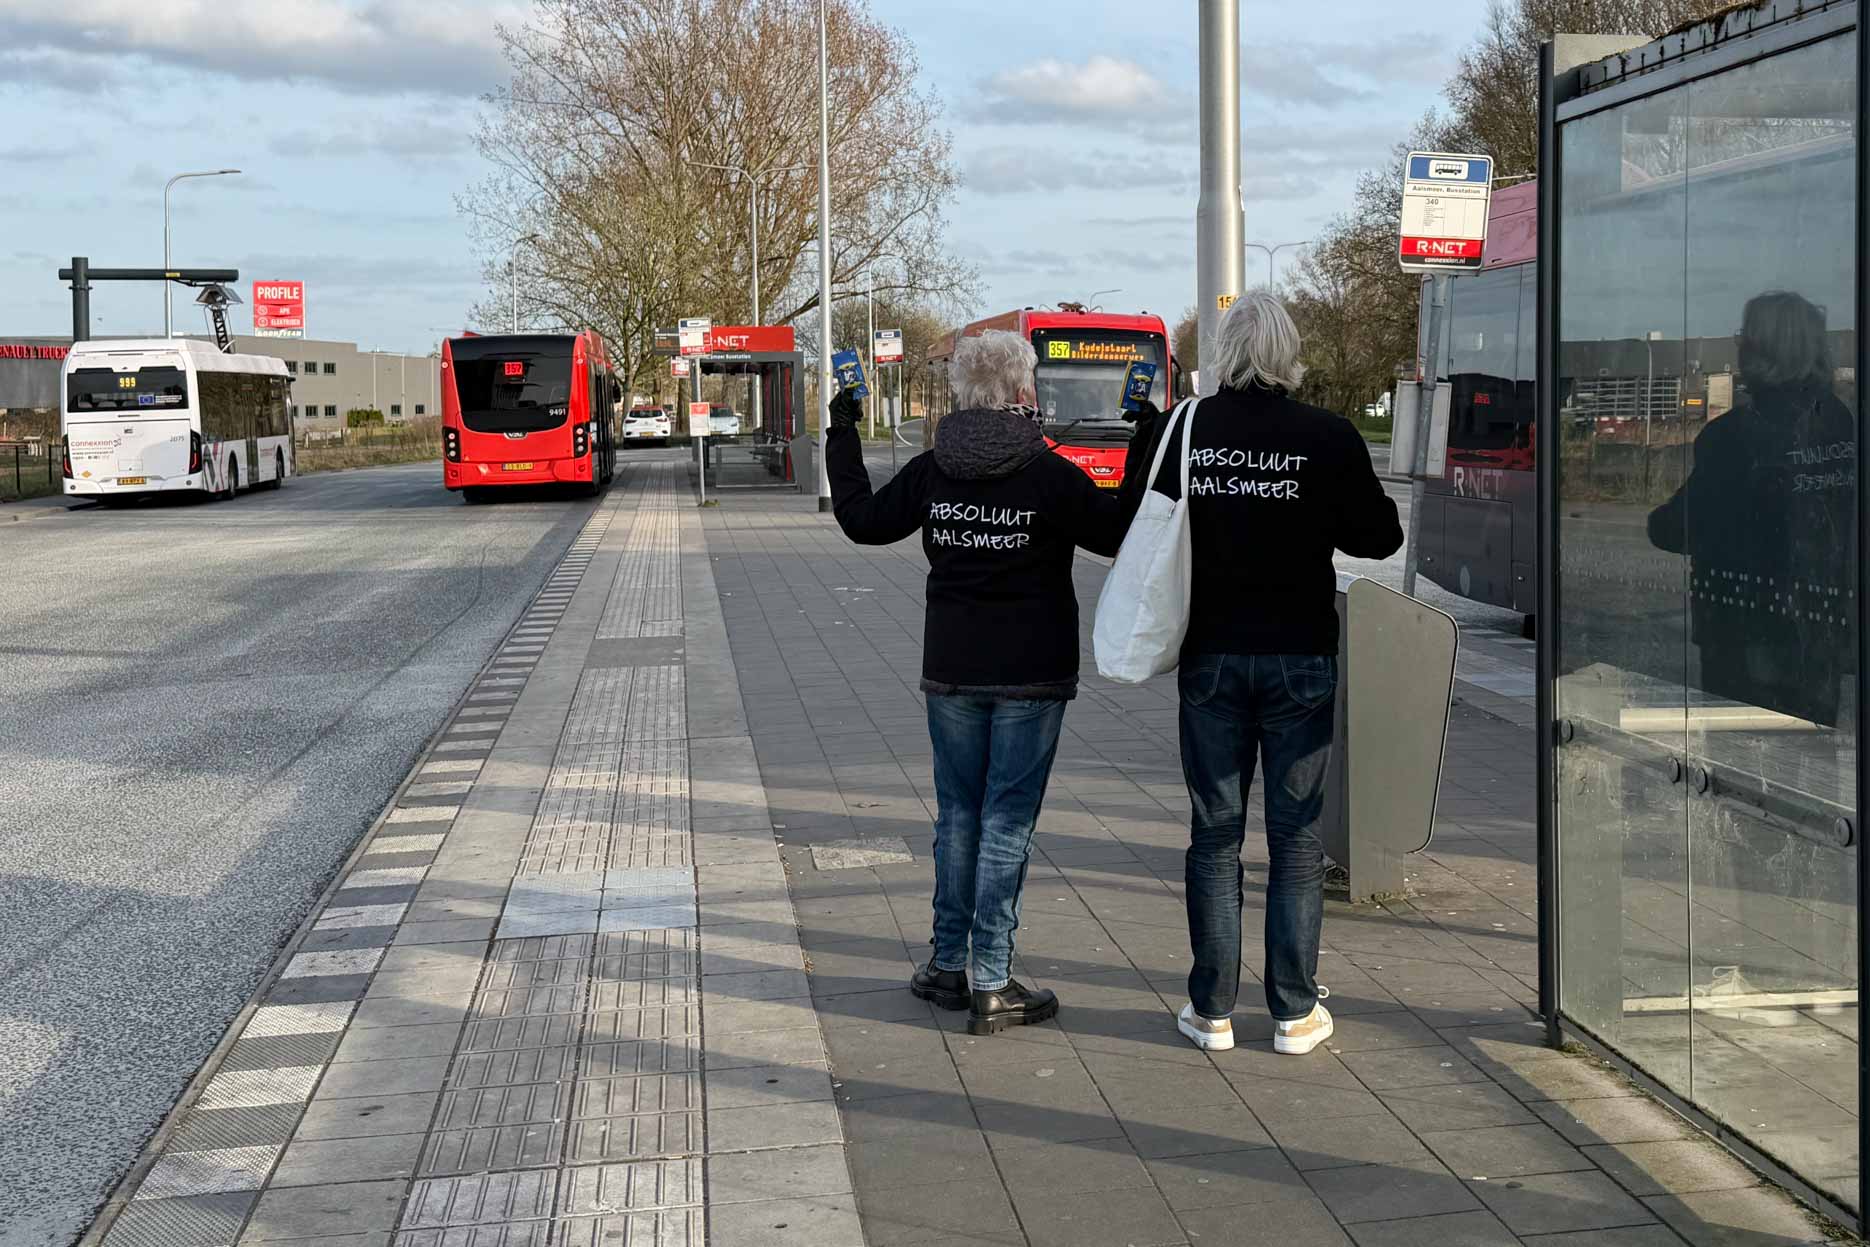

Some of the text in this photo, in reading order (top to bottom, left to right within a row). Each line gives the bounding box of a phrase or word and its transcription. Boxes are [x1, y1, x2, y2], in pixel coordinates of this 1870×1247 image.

[1412, 185, 1445, 193] Aalsmeer,
[1425, 198, 1439, 206] 340
[257, 286, 300, 300] PROFILE
[1050, 341, 1137, 357] 357 Kudelstaart
[504, 361, 524, 376] 357
[119, 376, 136, 388] 999
[548, 408, 567, 416] 9491
[1189, 447, 1308, 472] ABSOLUUT
[1189, 476, 1300, 500] AALSMEER
[929, 502, 1037, 526] ABSOLUUT
[932, 527, 1030, 550] AALSMEER
